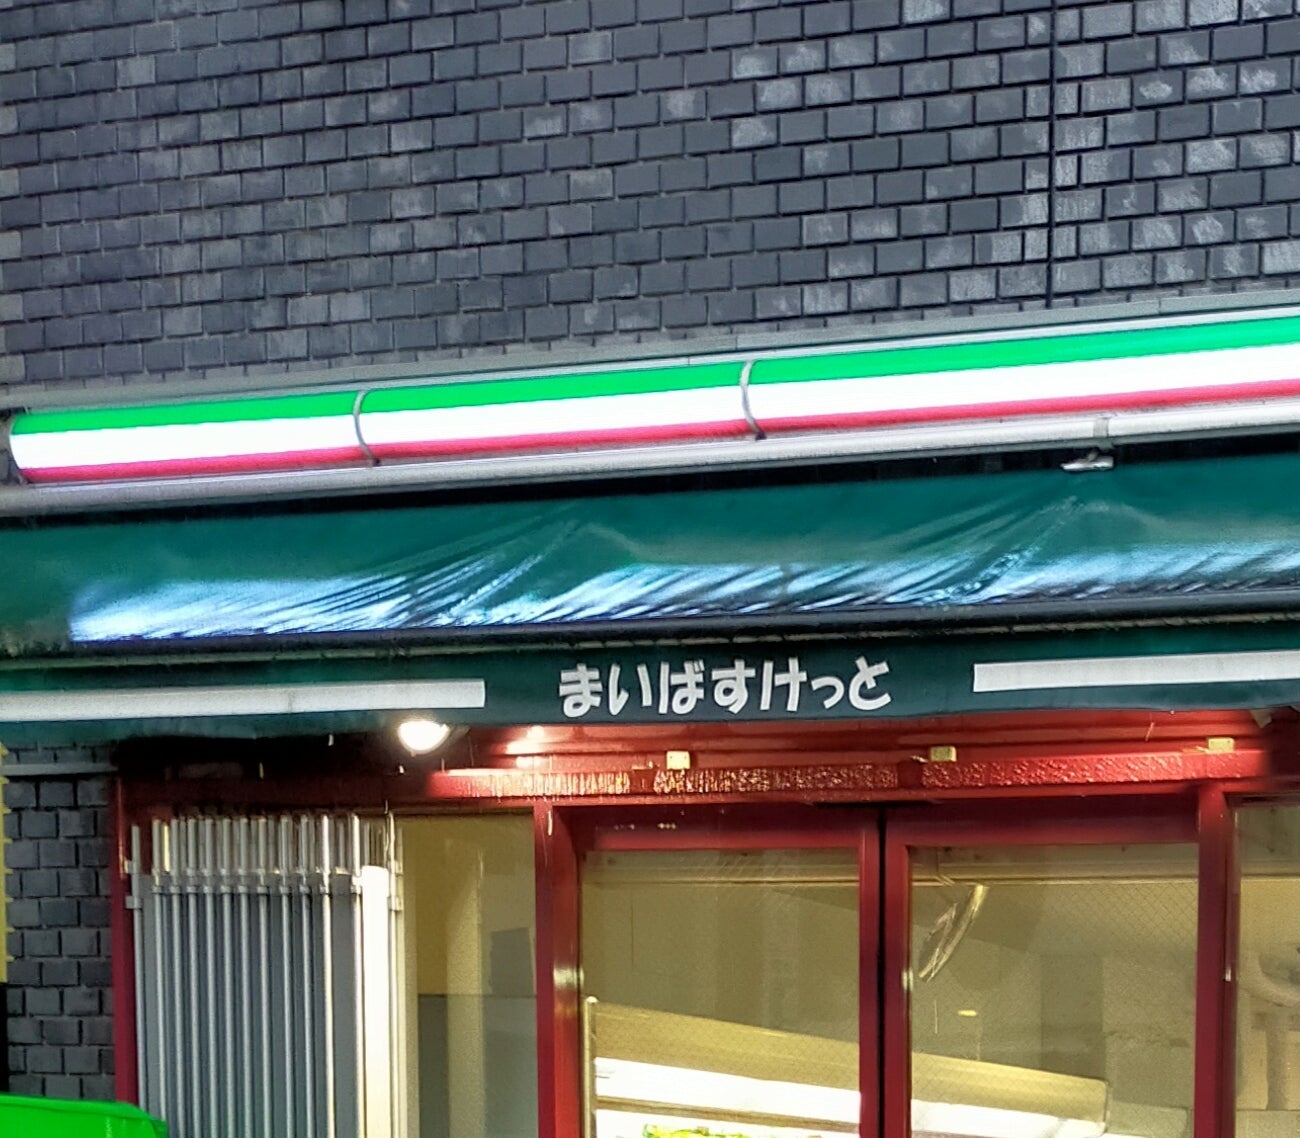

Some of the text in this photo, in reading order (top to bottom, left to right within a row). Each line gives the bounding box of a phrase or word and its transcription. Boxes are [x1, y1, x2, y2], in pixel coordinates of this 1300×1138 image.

[557, 656, 893, 718] まいばすけっと
